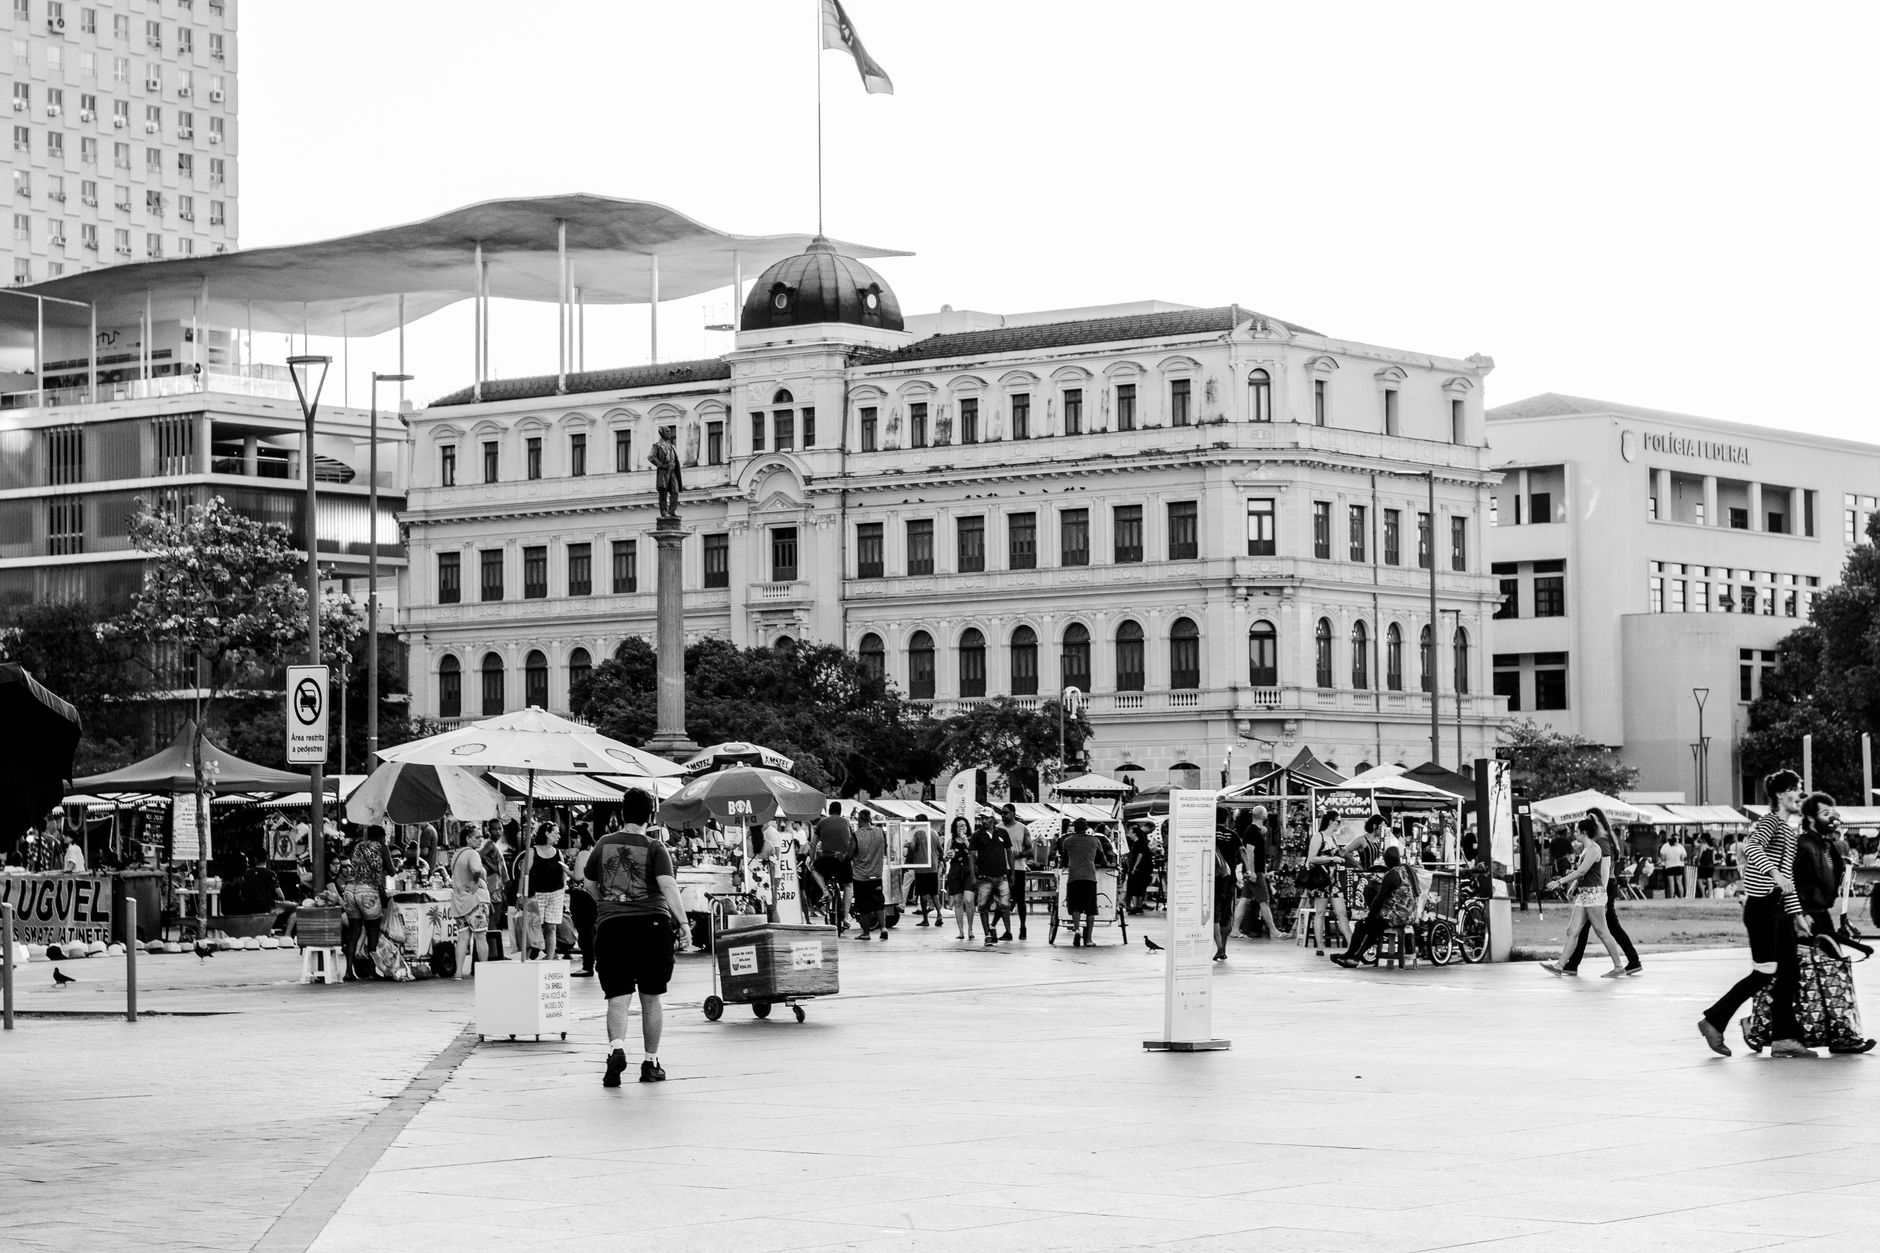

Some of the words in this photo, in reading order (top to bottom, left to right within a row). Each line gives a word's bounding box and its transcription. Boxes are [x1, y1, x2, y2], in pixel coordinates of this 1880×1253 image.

[1644, 432, 1694, 457] POLÍCIA
[1698, 440, 1752, 465] FEDERAL
[291, 733, 304, 741] Área
[297, 745, 322, 754] pedestres
[686, 758, 711, 772] AMSTEL
[764, 756, 790, 770] AMSTEL
[728, 800, 753, 815] BOA
[0, 879, 110, 922] LUGUEL
[25, 926, 54, 943] SKATE
[448, 924, 458, 937] DE
